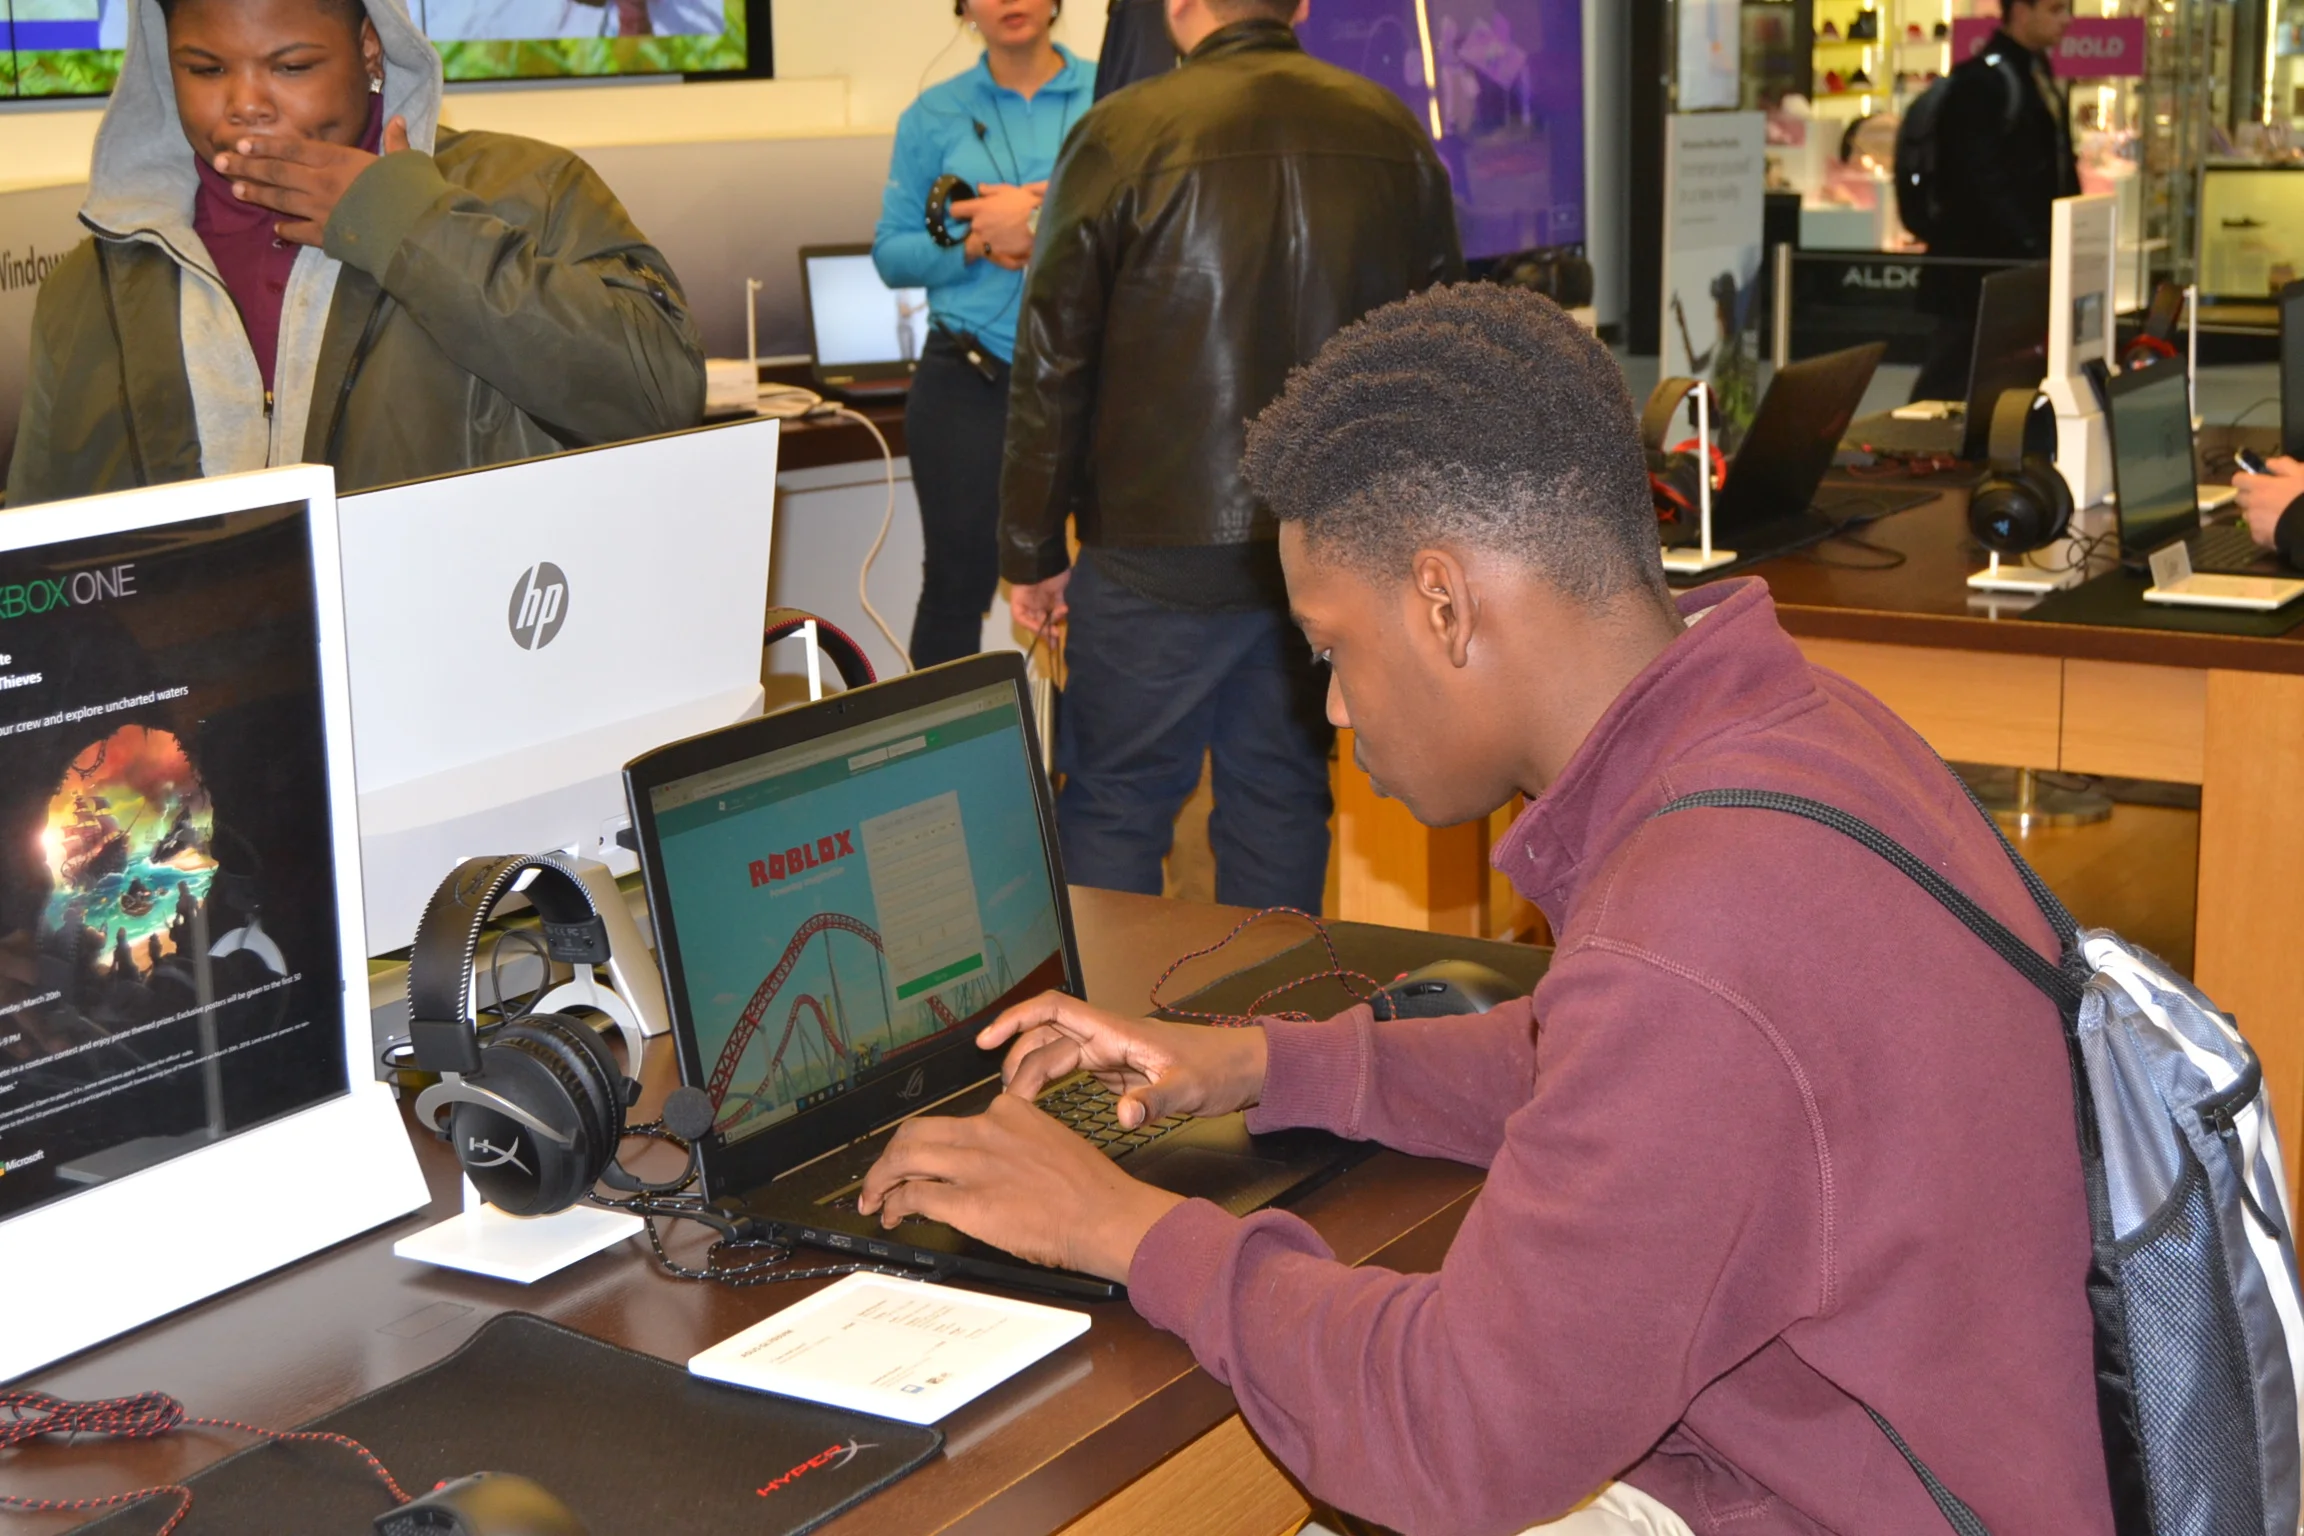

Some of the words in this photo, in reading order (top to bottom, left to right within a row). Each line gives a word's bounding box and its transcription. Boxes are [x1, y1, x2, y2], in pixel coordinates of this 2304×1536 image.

[2060, 36, 2126, 58] BOLD
[72, 563, 137, 605] ONE
[509, 561, 568, 650] hp
[16, 719, 41, 733] crew
[44, 712, 64, 727] and
[65, 703, 104, 722] explore
[106, 691, 155, 713] uncharted
[157, 685, 189, 700] waters
[748, 829, 856, 888] ROBLOX
[23, 998, 45, 1008] March
[25, 1055, 54, 1070] costume
[54, 1046, 78, 1060] contest
[79, 1040, 92, 1053] and
[93, 1036, 111, 1048] enjoy
[111, 1030, 131, 1043] pirate
[131, 1020, 155, 1035] themed
[177, 1005, 204, 1021] Exclusive
[205, 998, 226, 1013] posters
[227, 993, 237, 1004] will
[238, 991, 246, 1000] be
[246, 986, 262, 999] given
[263, 983, 271, 992] to
[271, 979, 281, 989] the
[294, 972, 302, 981] 50
[9, 1033, 21, 1044] PM
[5, 1149, 45, 1171] Microsoft
